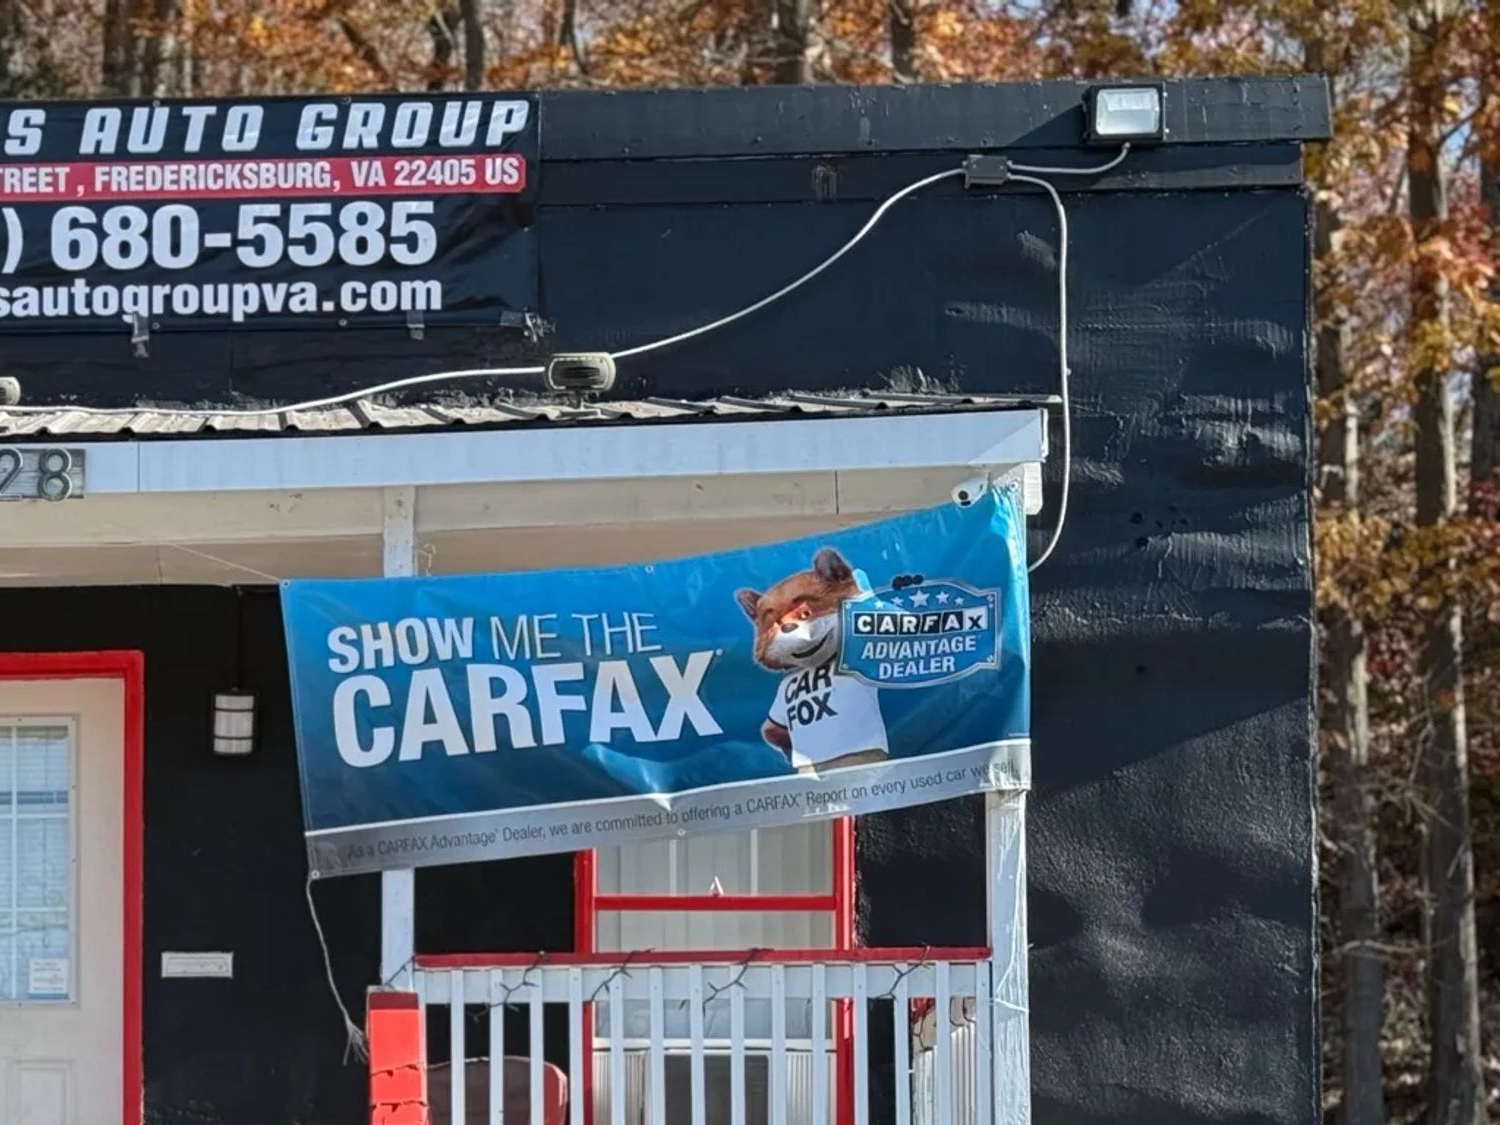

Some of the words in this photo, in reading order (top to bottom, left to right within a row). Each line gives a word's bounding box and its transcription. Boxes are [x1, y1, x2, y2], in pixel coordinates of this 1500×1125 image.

[79, 104, 264, 155] AUTO
[296, 100, 530, 150] GROUP
[94, 162, 341, 193] FREDERICKSBURG,
[351, 160, 387, 187] VA
[393, 158, 477, 187] 22405
[484, 157, 521, 185] US
[51, 200, 438, 271] 680-5585
[328, 617, 473, 673] SHOW
[491, 614, 562, 659] ME
[571, 612, 663, 656] THE
[857, 612, 985, 632] CARFAX
[861, 635, 976, 660] ADVANTAGE
[878, 656, 956, 680] DEALER
[785, 662, 832, 704] CAR
[333, 650, 724, 768] CARFAX
[787, 691, 838, 731] FOX
[378, 836, 428, 855] CARFAX
[430, 830, 496, 849] Advantage
[503, 825, 546, 843] Dealer,
[549, 823, 568, 836] we
[572, 822, 592, 834] are
[595, 812, 662, 833] committed
[665, 810, 679, 825] to
[682, 803, 731, 823] offering
[735, 804, 743, 815] a
[747, 793, 799, 814] CARFAX
[806, 787, 849, 807] Report
[851, 785, 868, 798] on
[871, 776, 908, 797] every
[911, 769, 943, 788] used
[946, 768, 967, 780] car
[971, 762, 990, 776] we
